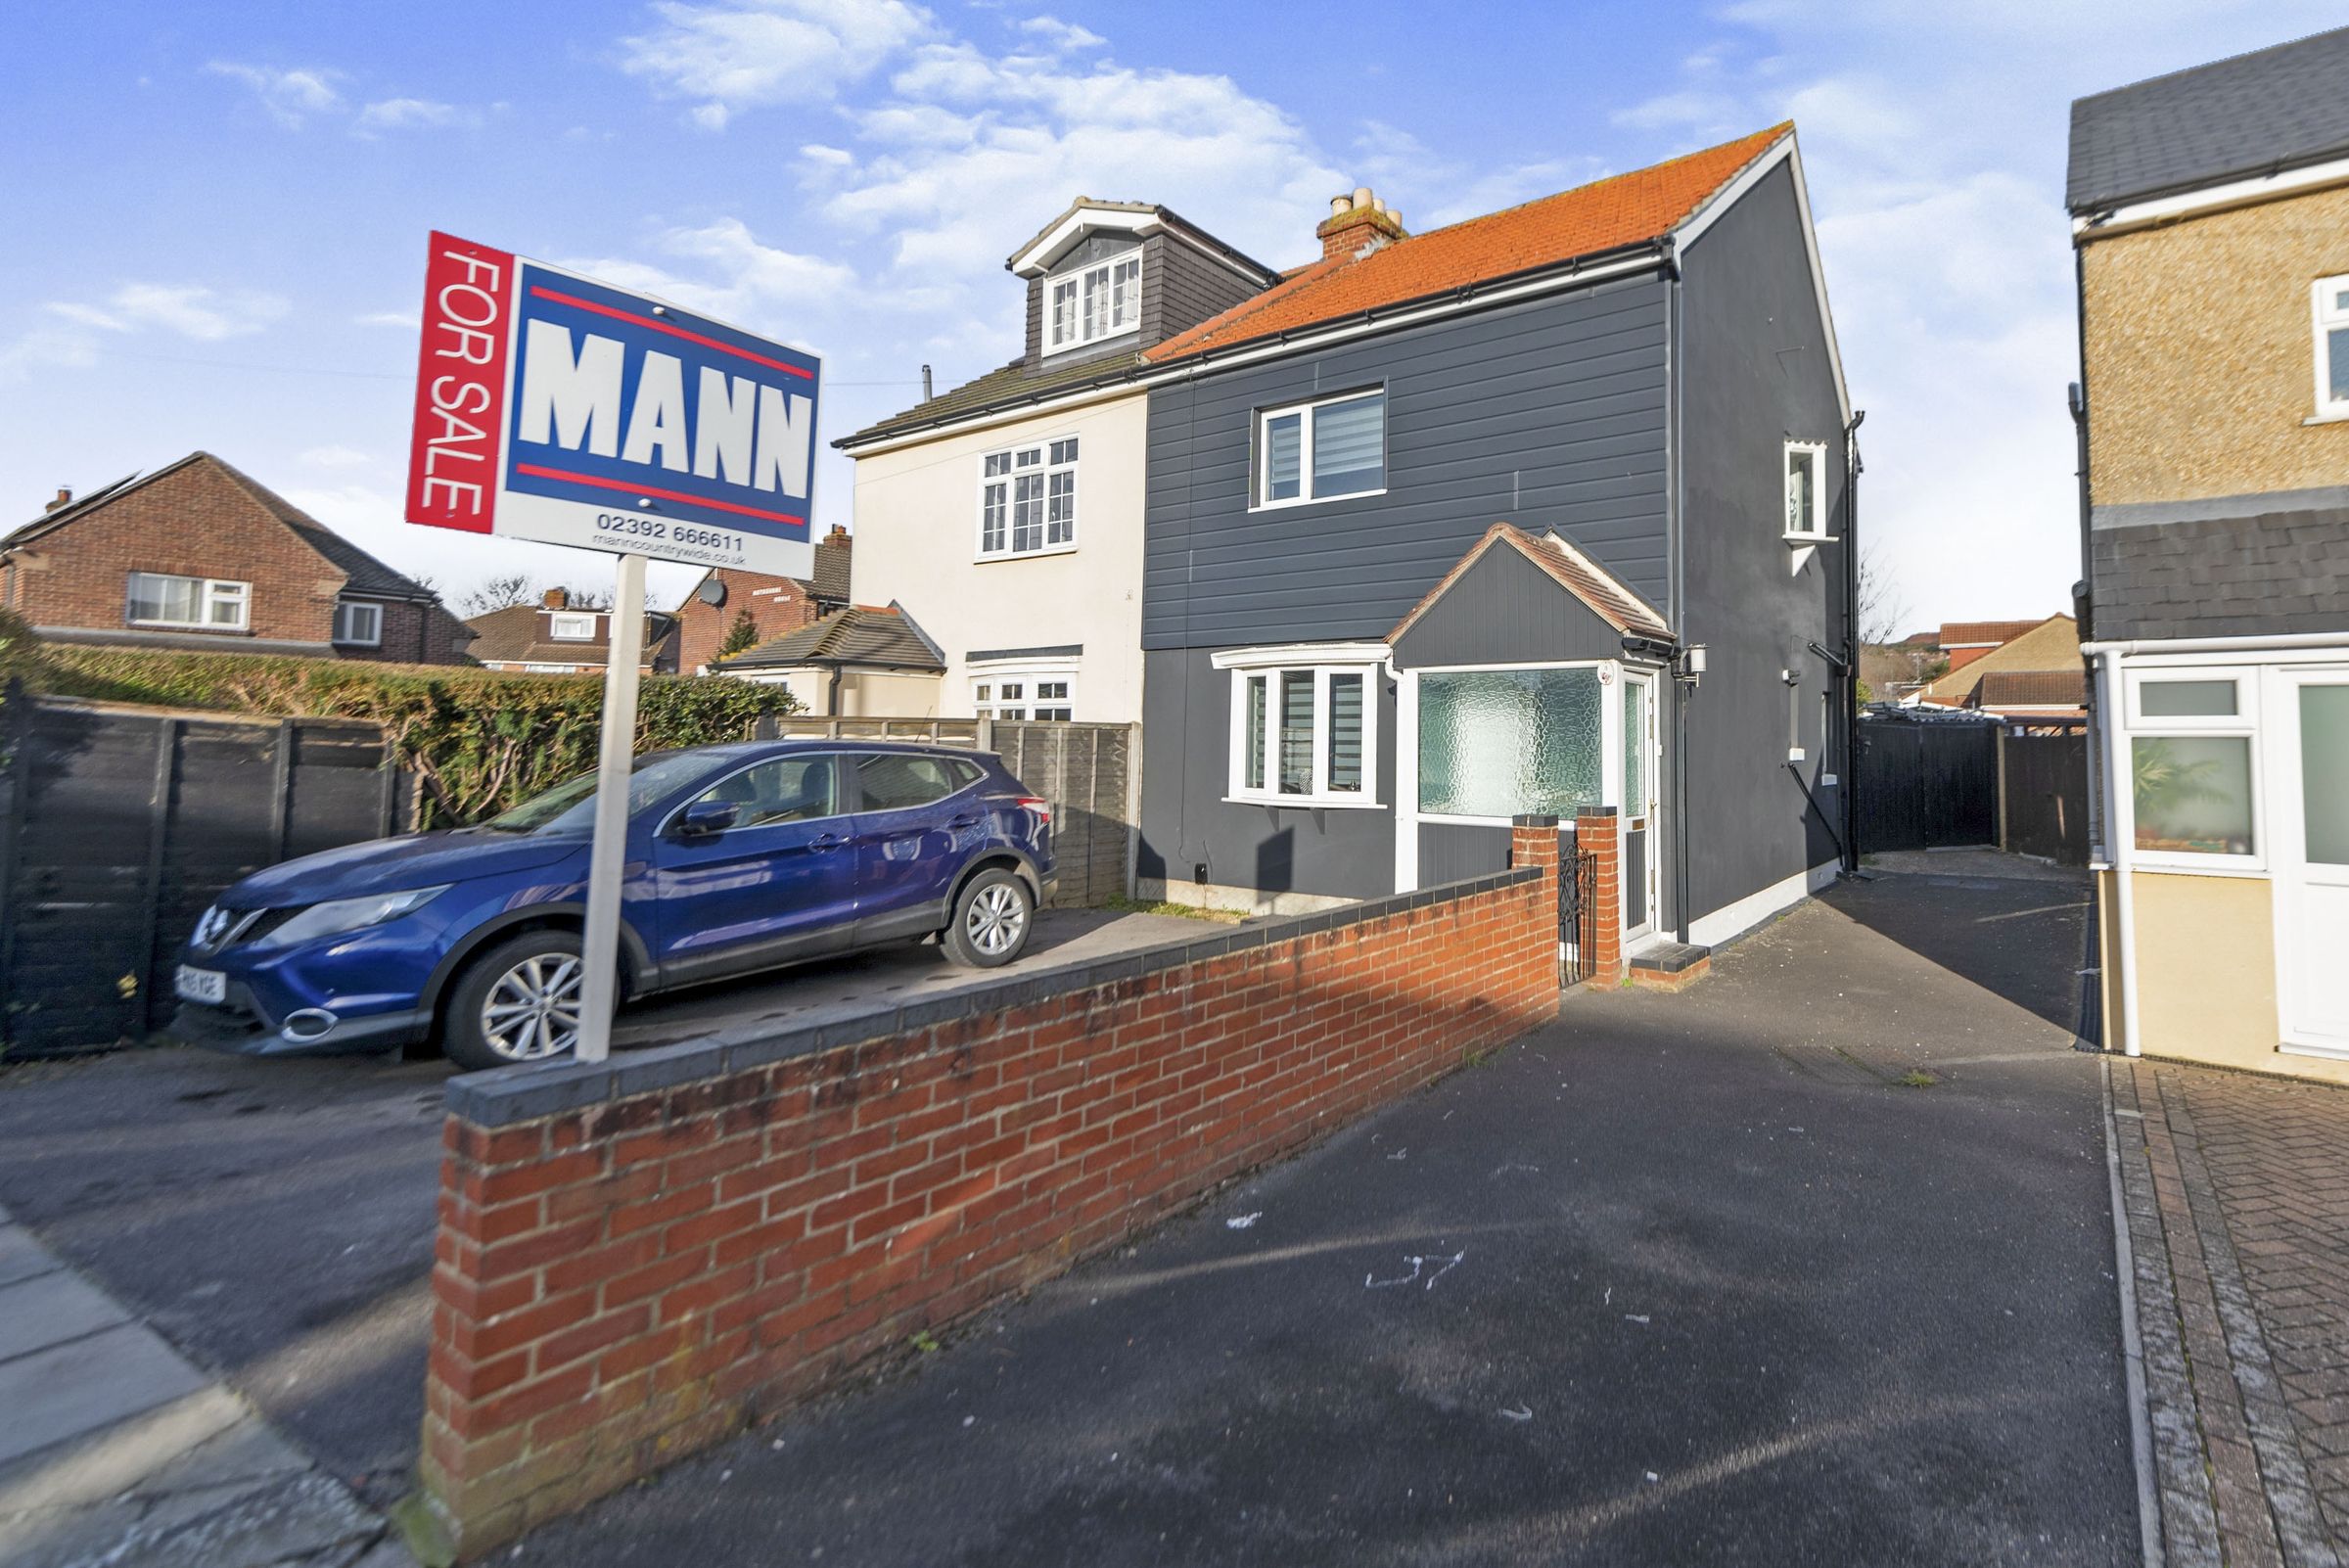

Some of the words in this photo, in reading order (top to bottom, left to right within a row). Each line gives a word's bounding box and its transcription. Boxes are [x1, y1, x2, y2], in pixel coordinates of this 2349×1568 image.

[436, 251, 500, 365] FOR
[422, 375, 491, 516] SALE
[518, 318, 812, 499] MANN
[592, 534, 746, 565] manncountrywide.co.uk
[597, 514, 666, 538] 02392
[673, 527, 742, 551] 666611
